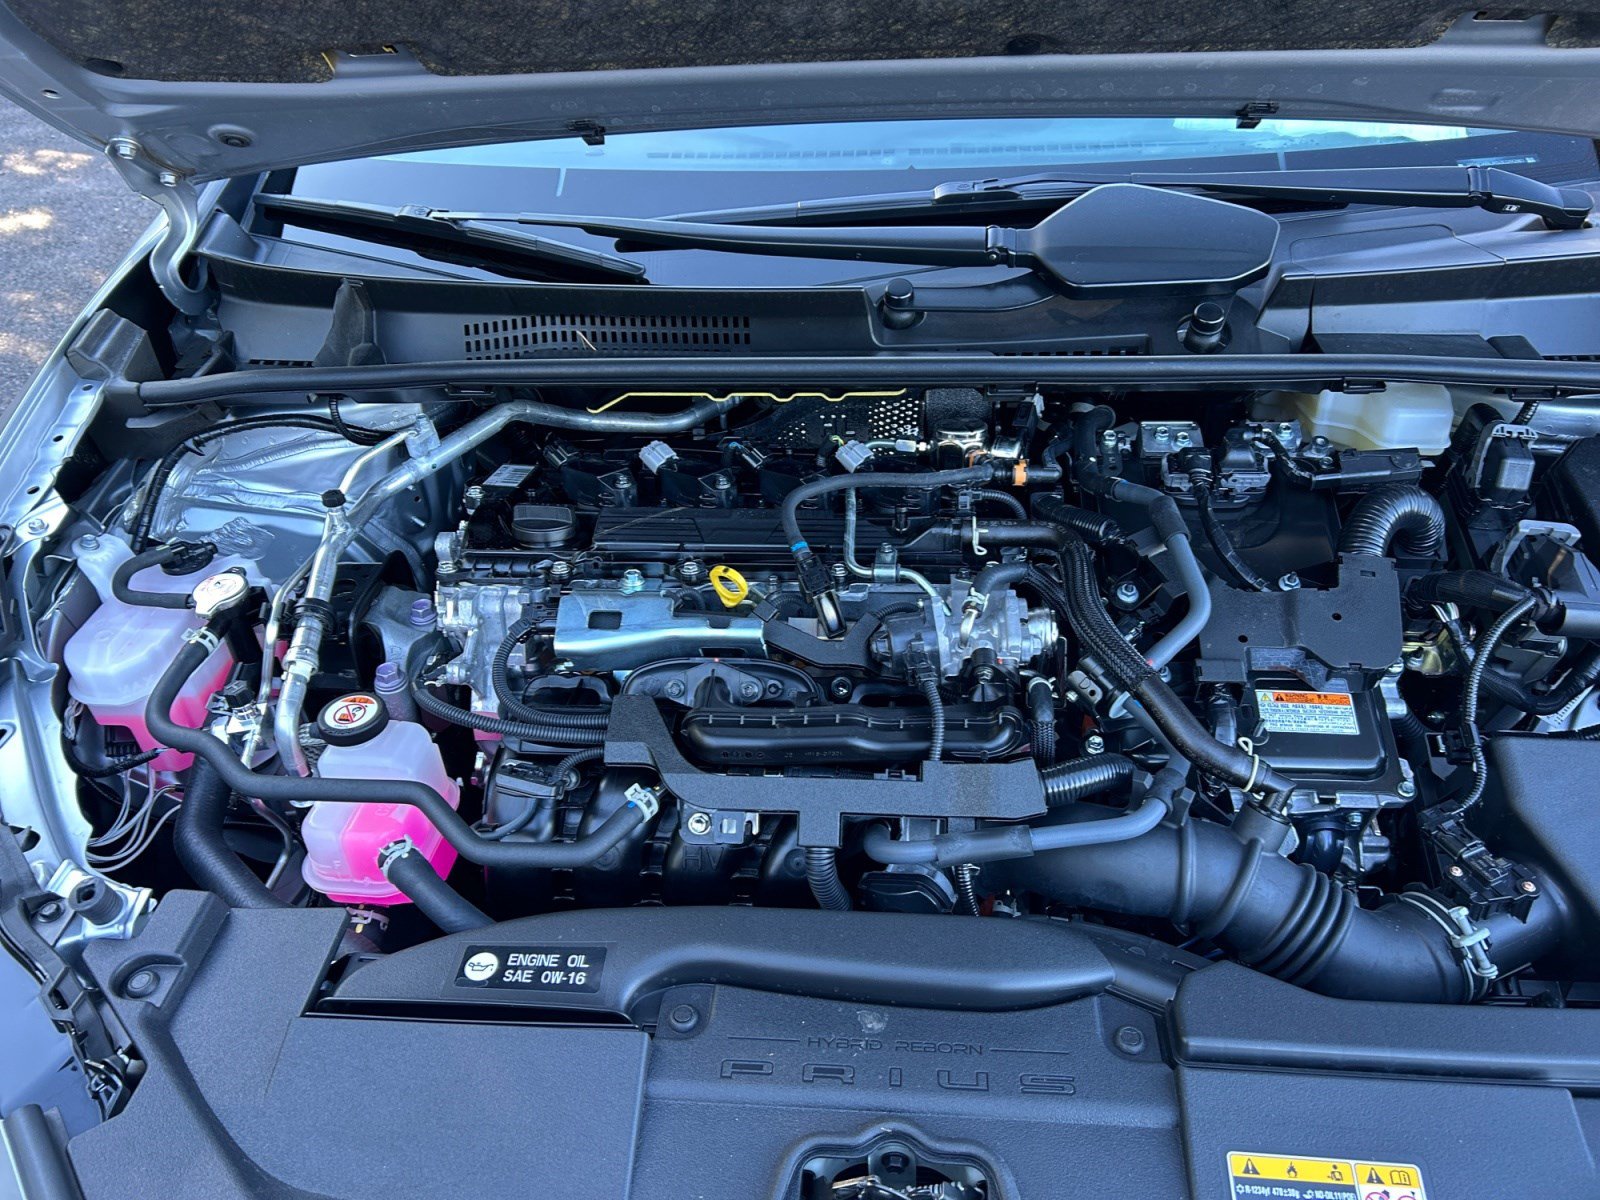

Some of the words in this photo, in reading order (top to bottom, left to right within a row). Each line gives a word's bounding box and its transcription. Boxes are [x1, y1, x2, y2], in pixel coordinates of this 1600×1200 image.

[682, 846, 724, 871] HV
[507, 953, 560, 967] ENGINE
[567, 954, 590, 968] OIL
[503, 969, 534, 983] SAE
[541, 971, 587, 985] 0W-16
[807, 1036, 882, 1051] HYBRID
[894, 1040, 983, 1055] REBORN
[719, 1058, 1076, 1095] PRIUS
